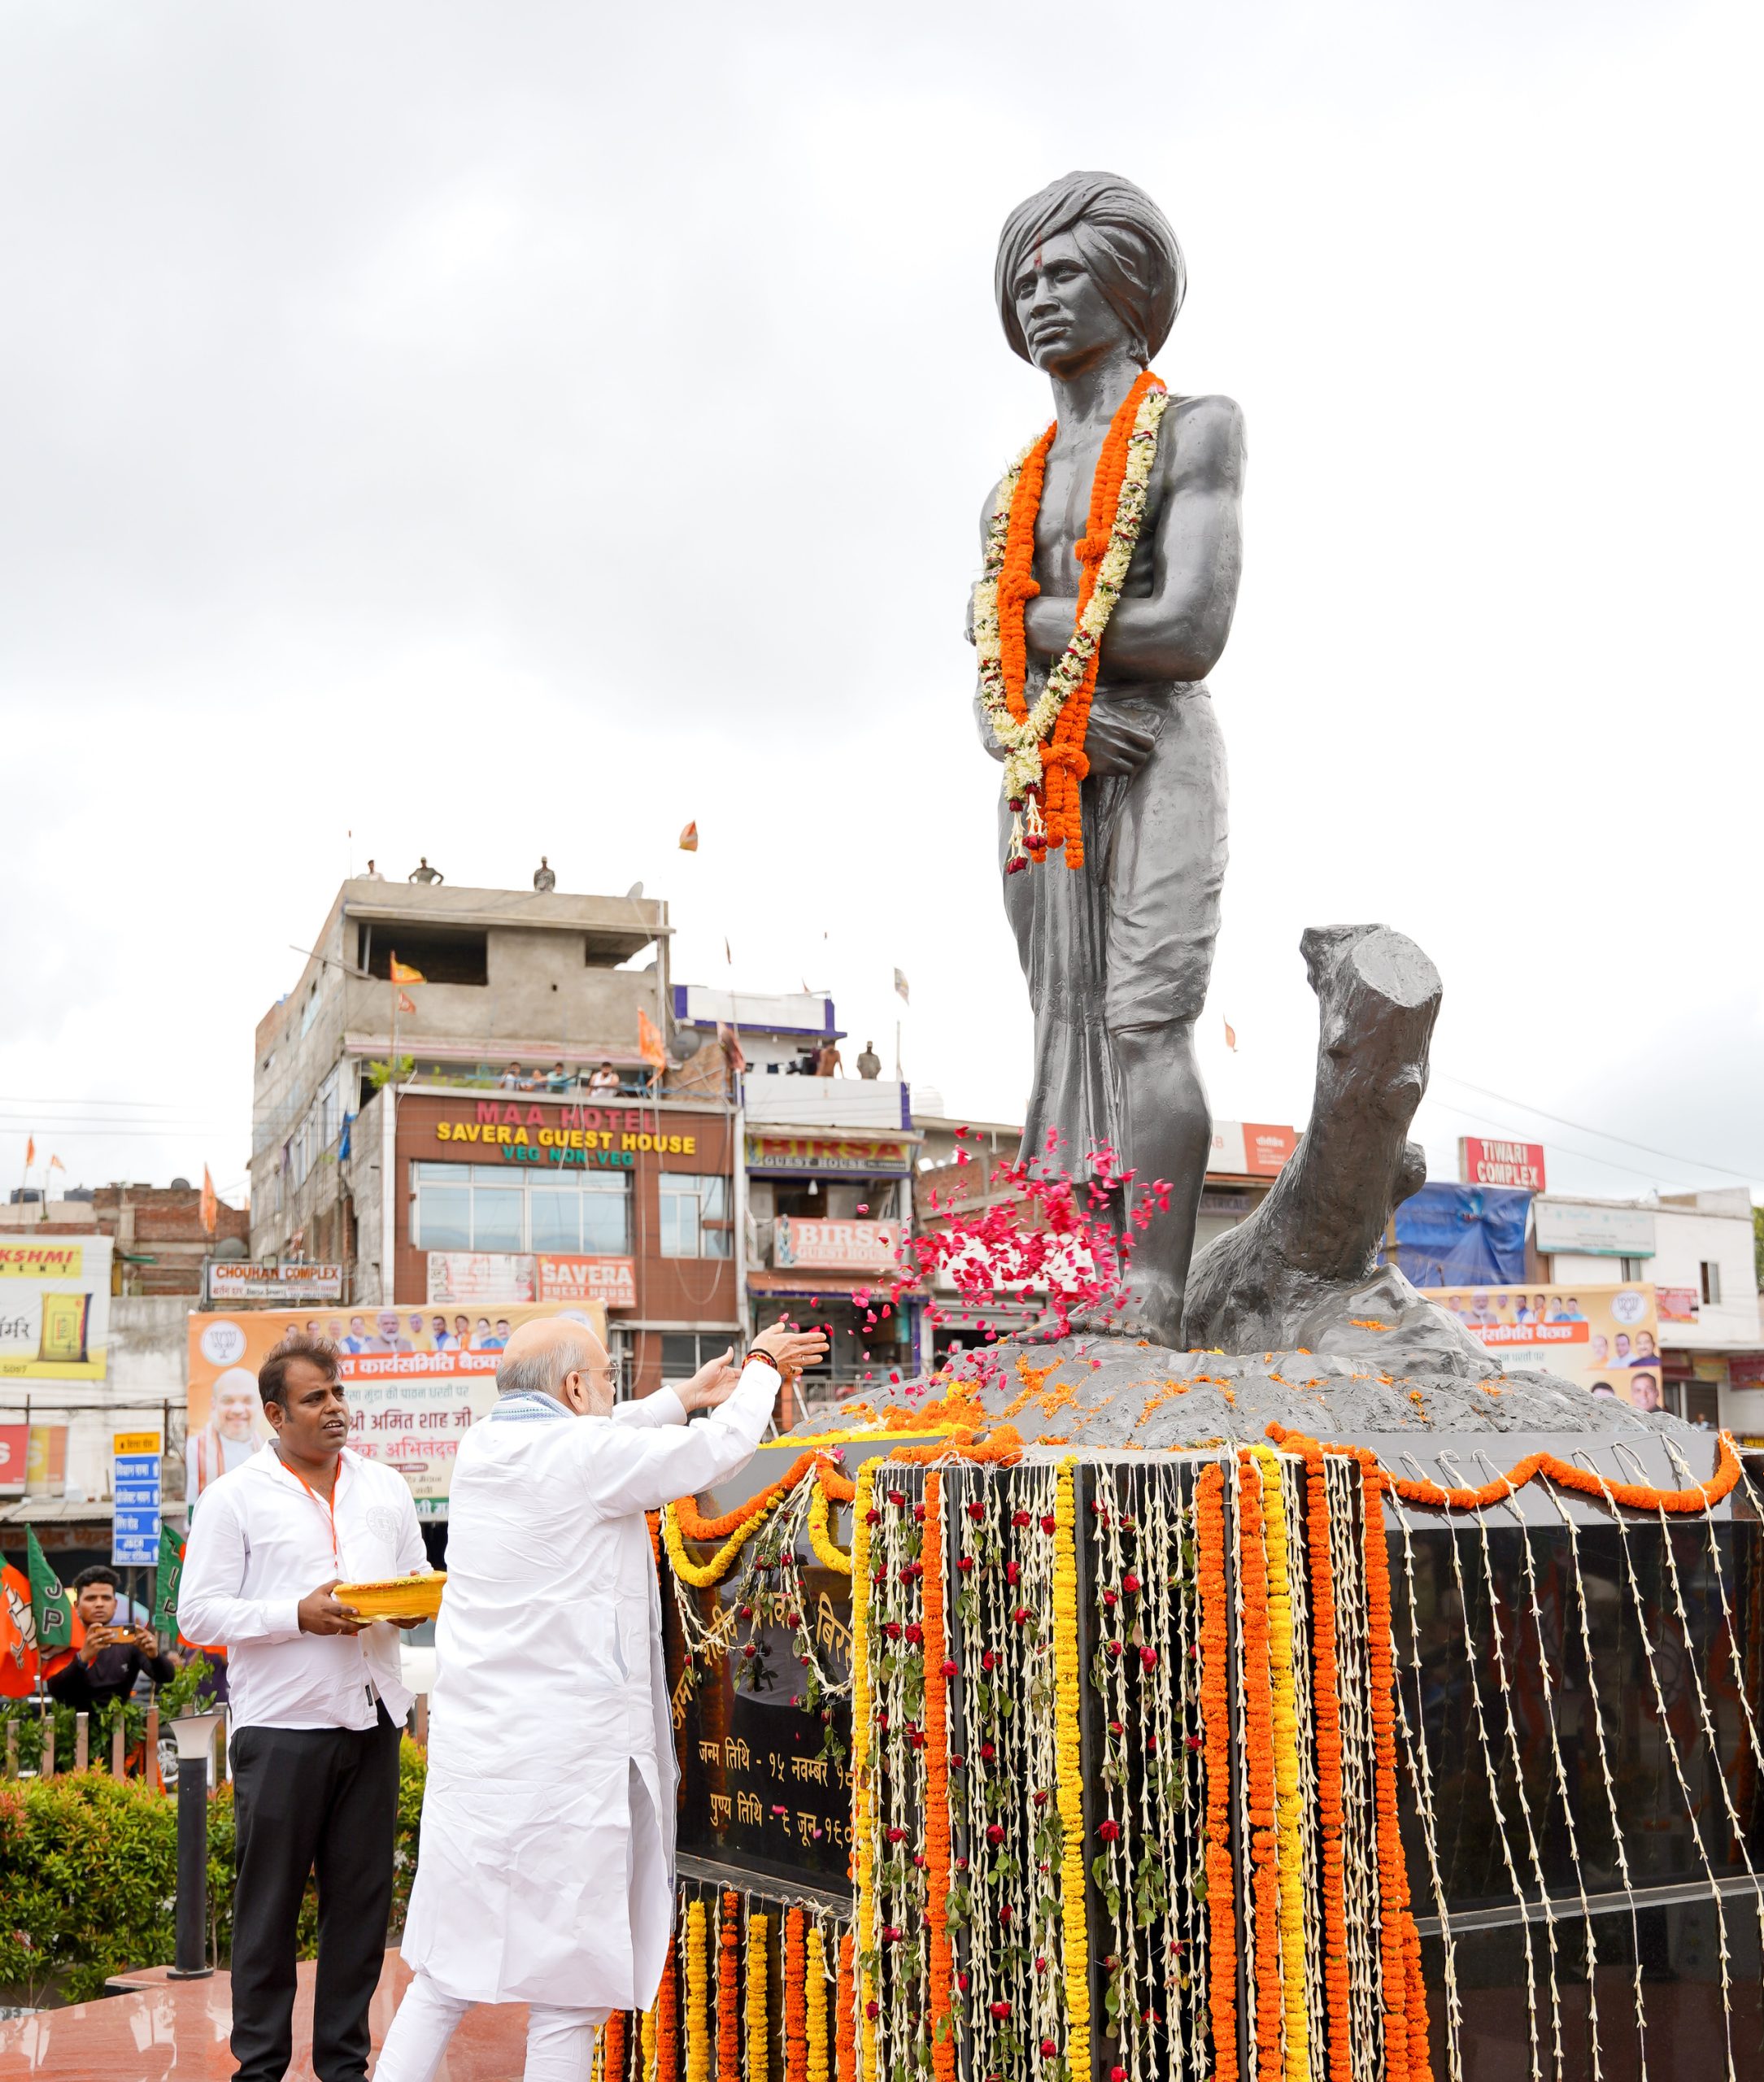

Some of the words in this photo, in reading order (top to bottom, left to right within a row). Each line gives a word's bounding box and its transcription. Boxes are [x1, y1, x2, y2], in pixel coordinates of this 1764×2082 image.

[477, 1101, 546, 1128] MAA
[560, 1105, 656, 1134] HOTEL
[437, 1122, 529, 1145] SAVERA
[538, 1127, 613, 1149] GUEST
[621, 1133, 696, 1155] HOUSE
[762, 1138, 904, 1159] BIRSA
[503, 1144, 540, 1161] VEG
[764, 1156, 812, 1167] GUEST
[817, 1158, 866, 1169] HOUSE
[1480, 1140, 1528, 1165] TIWARI
[1476, 1161, 1539, 1187] COMPLEX
[797, 1222, 896, 1248] BIRSA
[285, 1267, 338, 1280] COMPLEX
[541, 1262, 633, 1285] SAVERA
[542, 1285, 585, 1297] GUEST
[359, 1352, 455, 1374] कार्यसमिति
[371, 1409, 415, 1431] अमित
[420, 1411, 449, 1429] शाह
[452, 1406, 473, 1426] जी
[699, 1740, 720, 1766] जन्म
[725, 1736, 750, 1772] तिथि
[791, 1756, 829, 1788] नवम्बर
[709, 1792, 732, 1827] पुण्य
[737, 1790, 763, 1827] तिथि
[796, 1810, 817, 1848] जून
